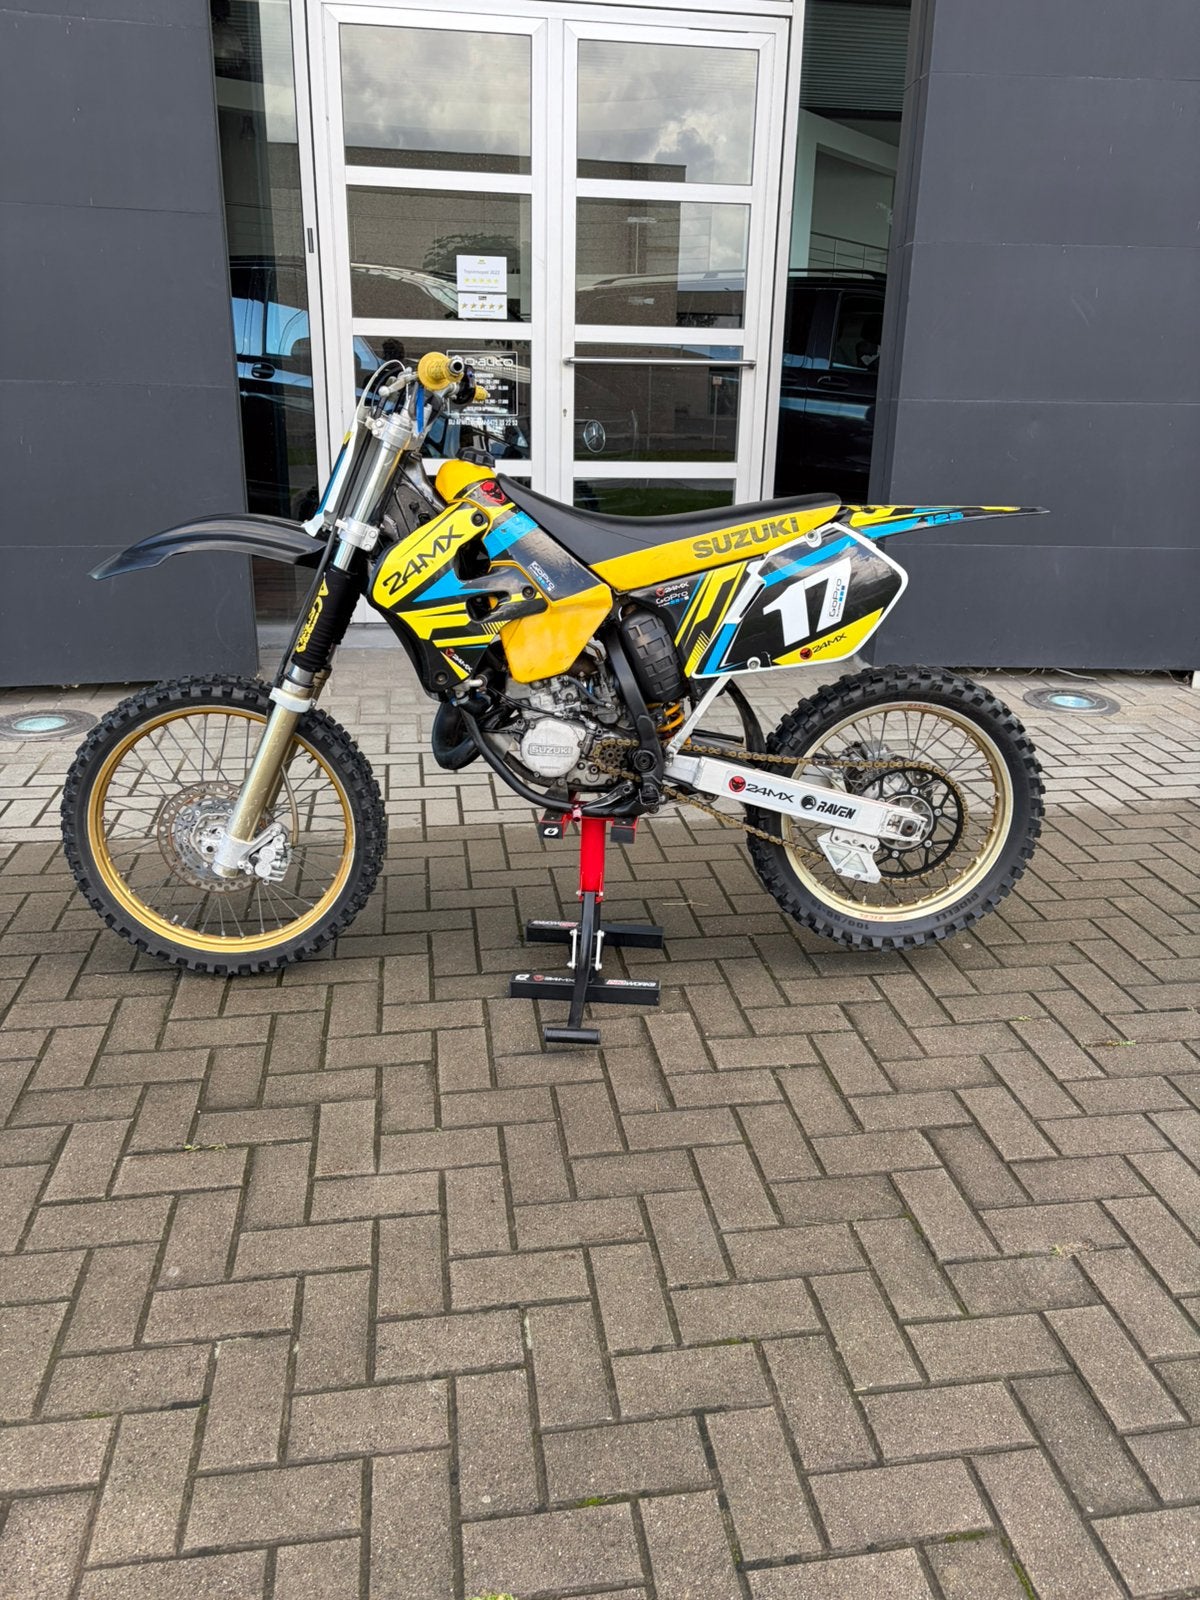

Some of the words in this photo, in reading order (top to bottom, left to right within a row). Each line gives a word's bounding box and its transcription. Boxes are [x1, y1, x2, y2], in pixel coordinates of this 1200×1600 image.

[692, 516, 800, 560] SUZUKI
[382, 524, 464, 596] 24MX
[655, 591, 689, 605] GoPro
[762, 557, 852, 647] 17
[828, 578, 842, 618] GoPro
[812, 633, 847, 653] 24MX
[530, 746, 572, 754] SUZUKI
[745, 783, 795, 804] 24MX
[816, 801, 857, 820] RAVEN
